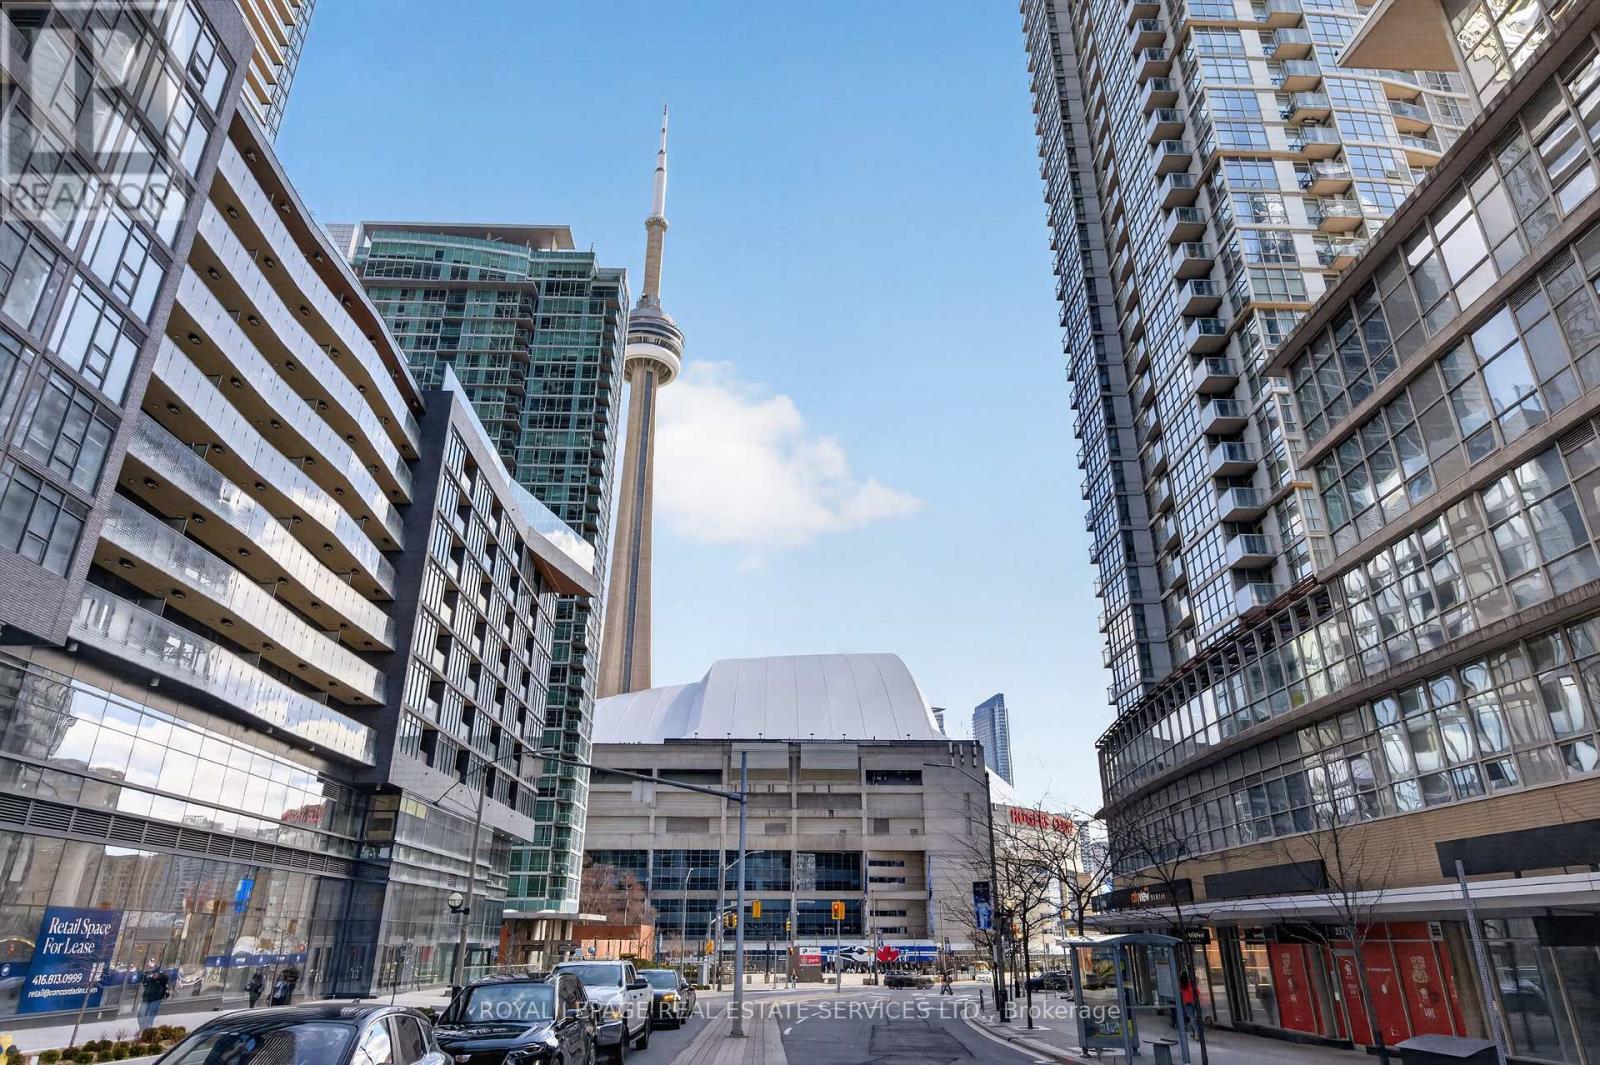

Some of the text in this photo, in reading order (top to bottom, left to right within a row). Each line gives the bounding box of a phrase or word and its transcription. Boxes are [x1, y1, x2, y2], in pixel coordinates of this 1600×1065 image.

[48, 917, 111, 938] Retail Space
[42, 937, 95, 954] For Lease
[32, 973, 83, 985] 416.813.0999
